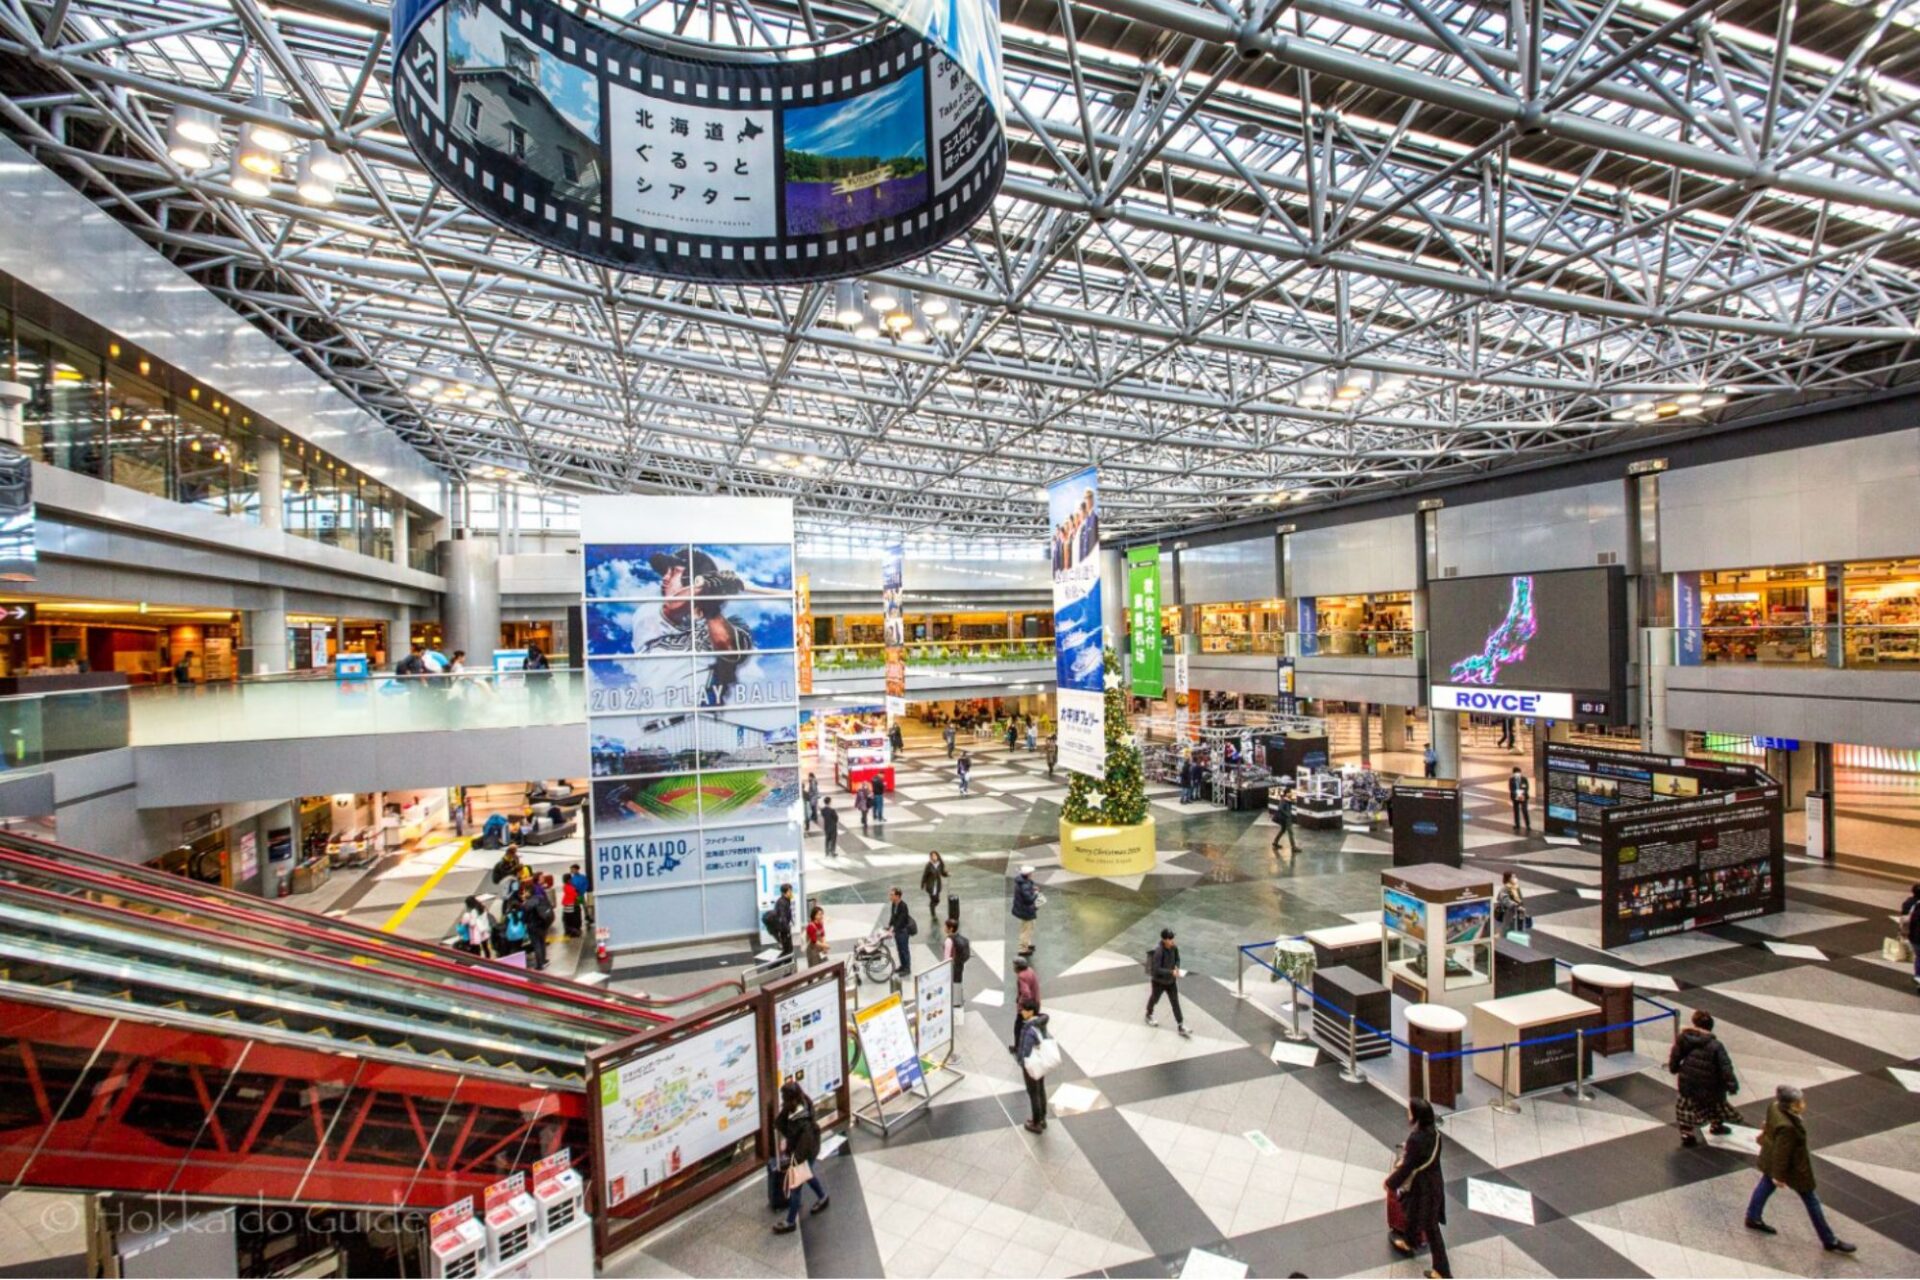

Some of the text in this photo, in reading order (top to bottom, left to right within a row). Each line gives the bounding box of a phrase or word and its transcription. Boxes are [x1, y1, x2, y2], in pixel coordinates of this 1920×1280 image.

[635, 108, 724, 142] 北海道
[635, 144, 749, 176] ぐるっと
[636, 176, 751, 205] シアター
[592, 682, 794, 712] 2023 PLAY BALL
[1456, 692, 1541, 713] ROYCE'
[599, 840, 686, 863] HOKKAIDO
[600, 861, 655, 881] PRIDE
